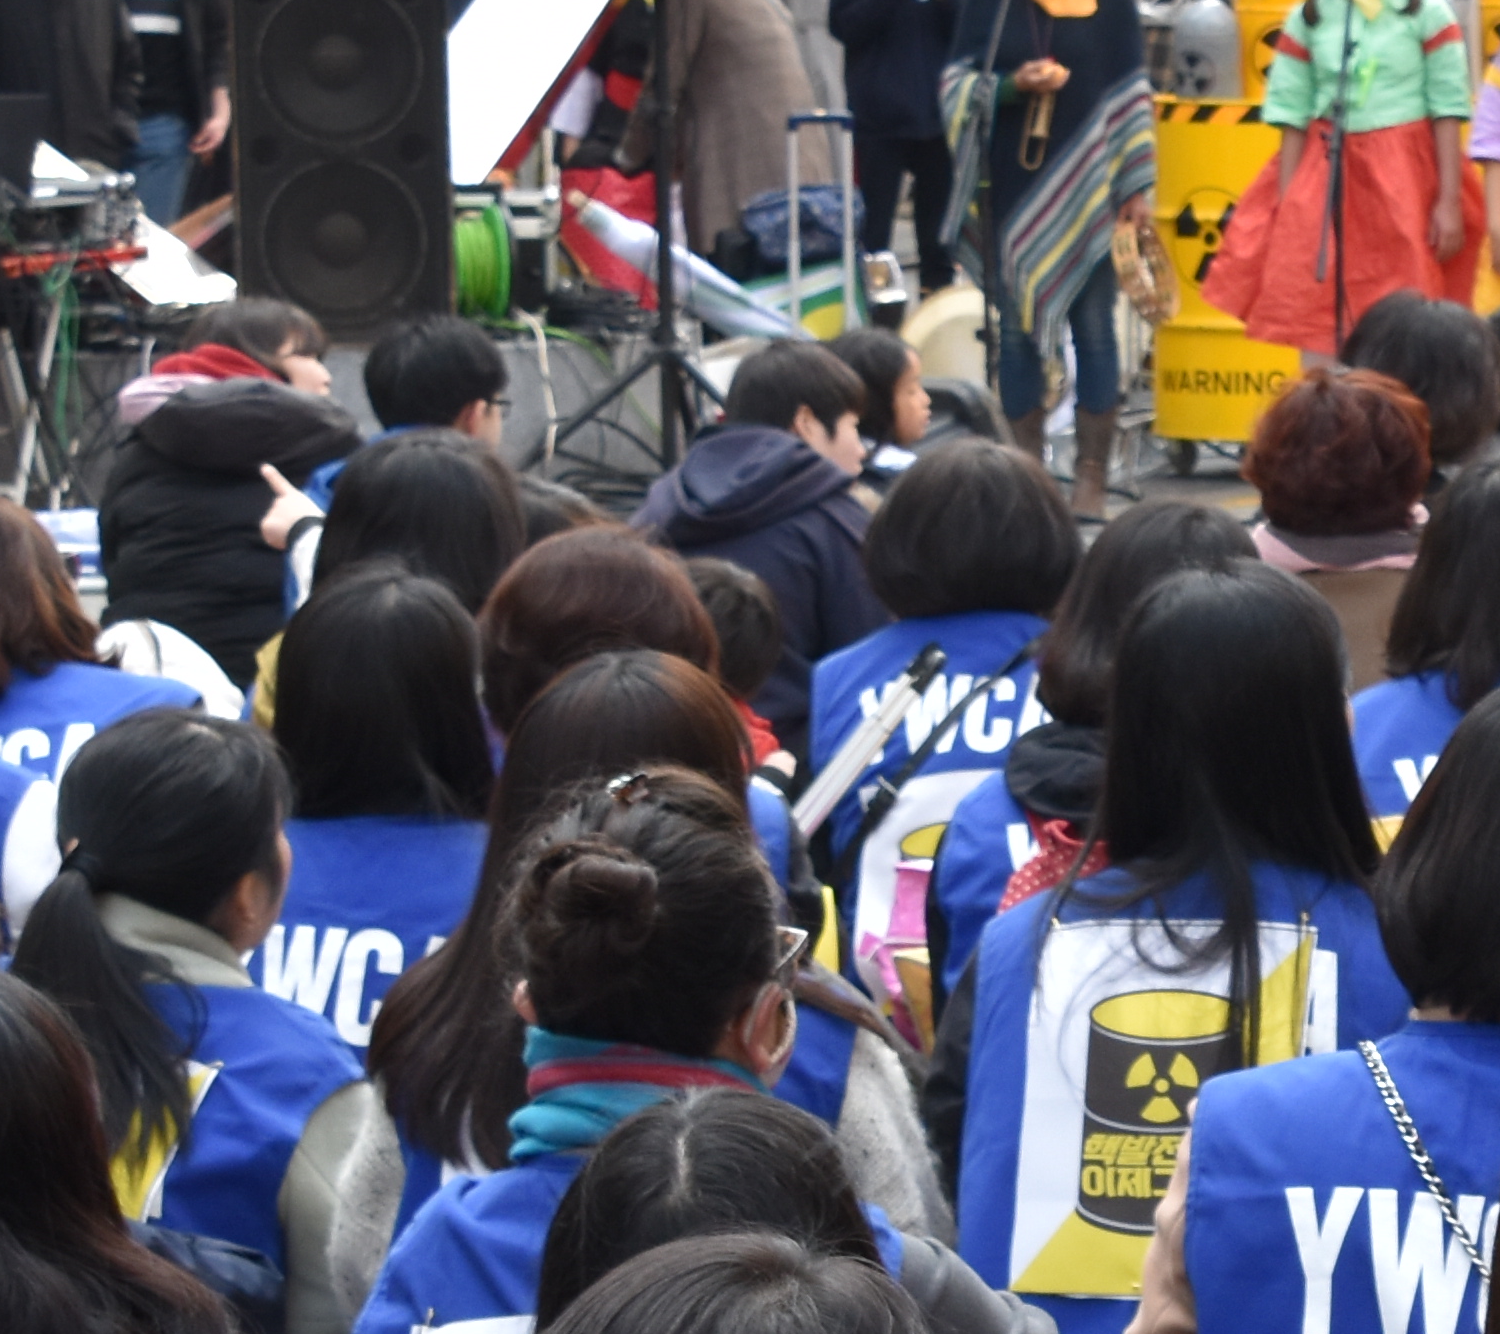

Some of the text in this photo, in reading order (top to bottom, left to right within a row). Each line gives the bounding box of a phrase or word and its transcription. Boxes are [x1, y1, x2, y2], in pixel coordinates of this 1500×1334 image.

[1161, 369, 1289, 395] WARNING
[241, 923, 449, 1047] WC
[1082, 1132, 1184, 1166] 핵발전
